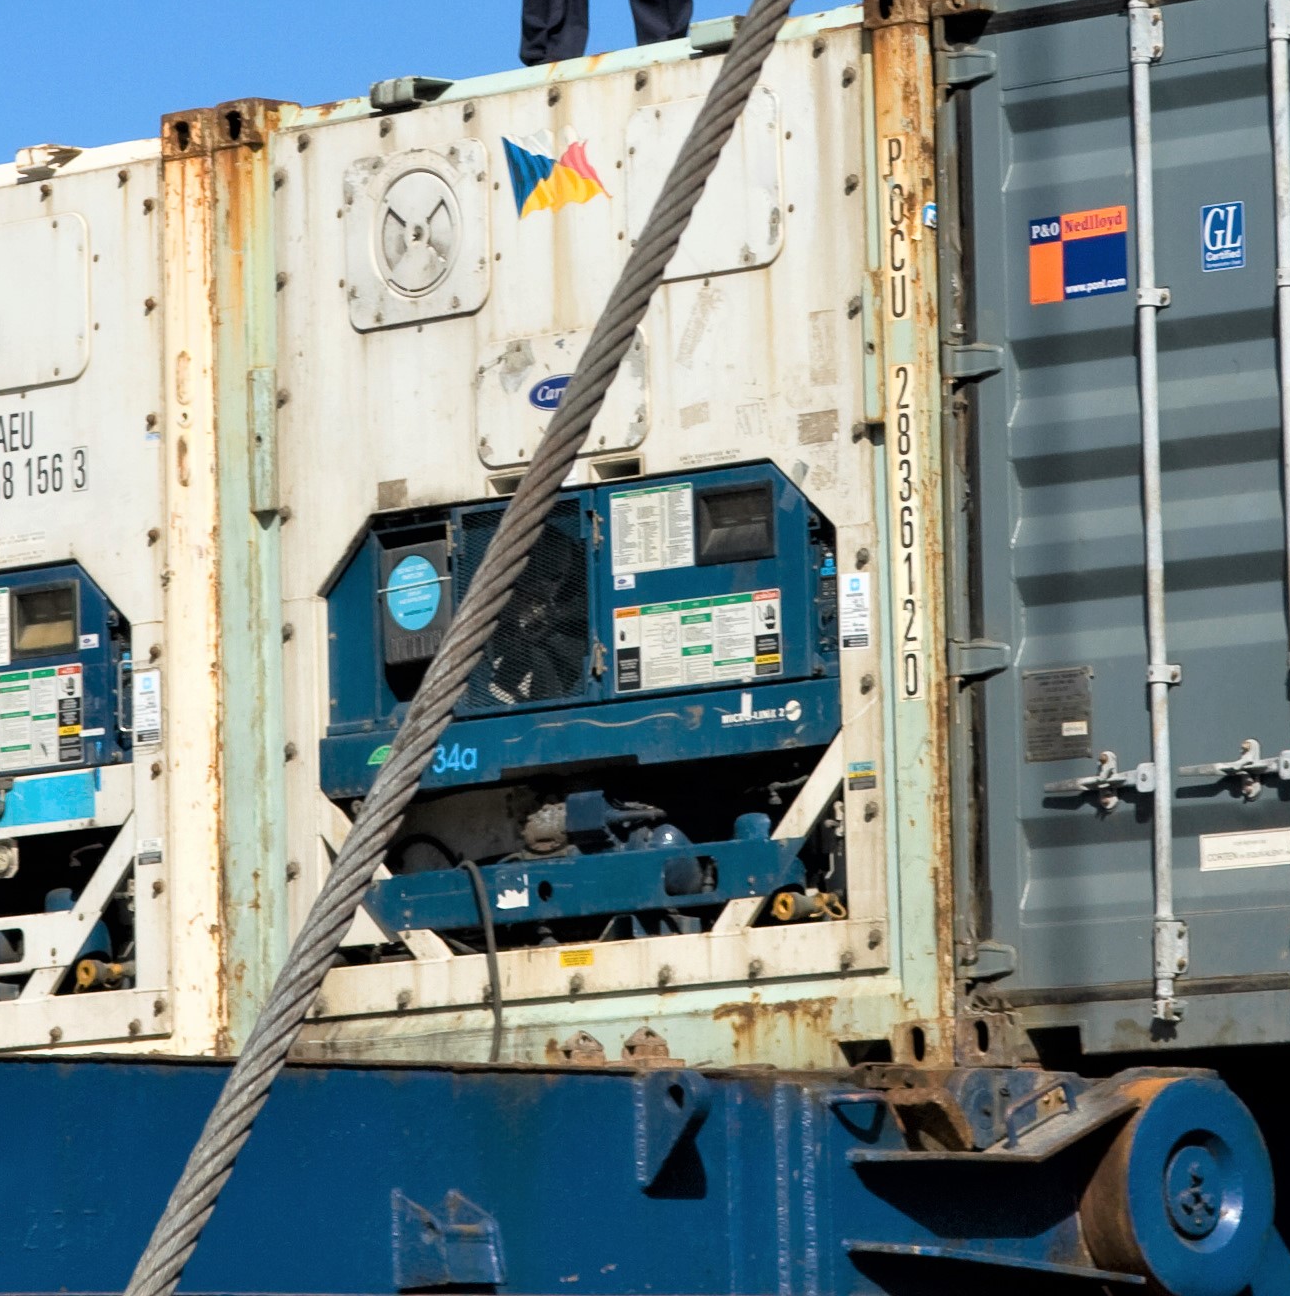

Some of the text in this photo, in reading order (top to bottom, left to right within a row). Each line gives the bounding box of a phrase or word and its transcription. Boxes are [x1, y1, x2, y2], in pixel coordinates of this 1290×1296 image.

[1031, 211, 1123, 239] P&O Nedlloyd
[1203, 206, 1243, 250] GL
[24, 453, 63, 497] 156
[73, 449, 86, 489] 3
[432, 743, 478, 773] 34a
